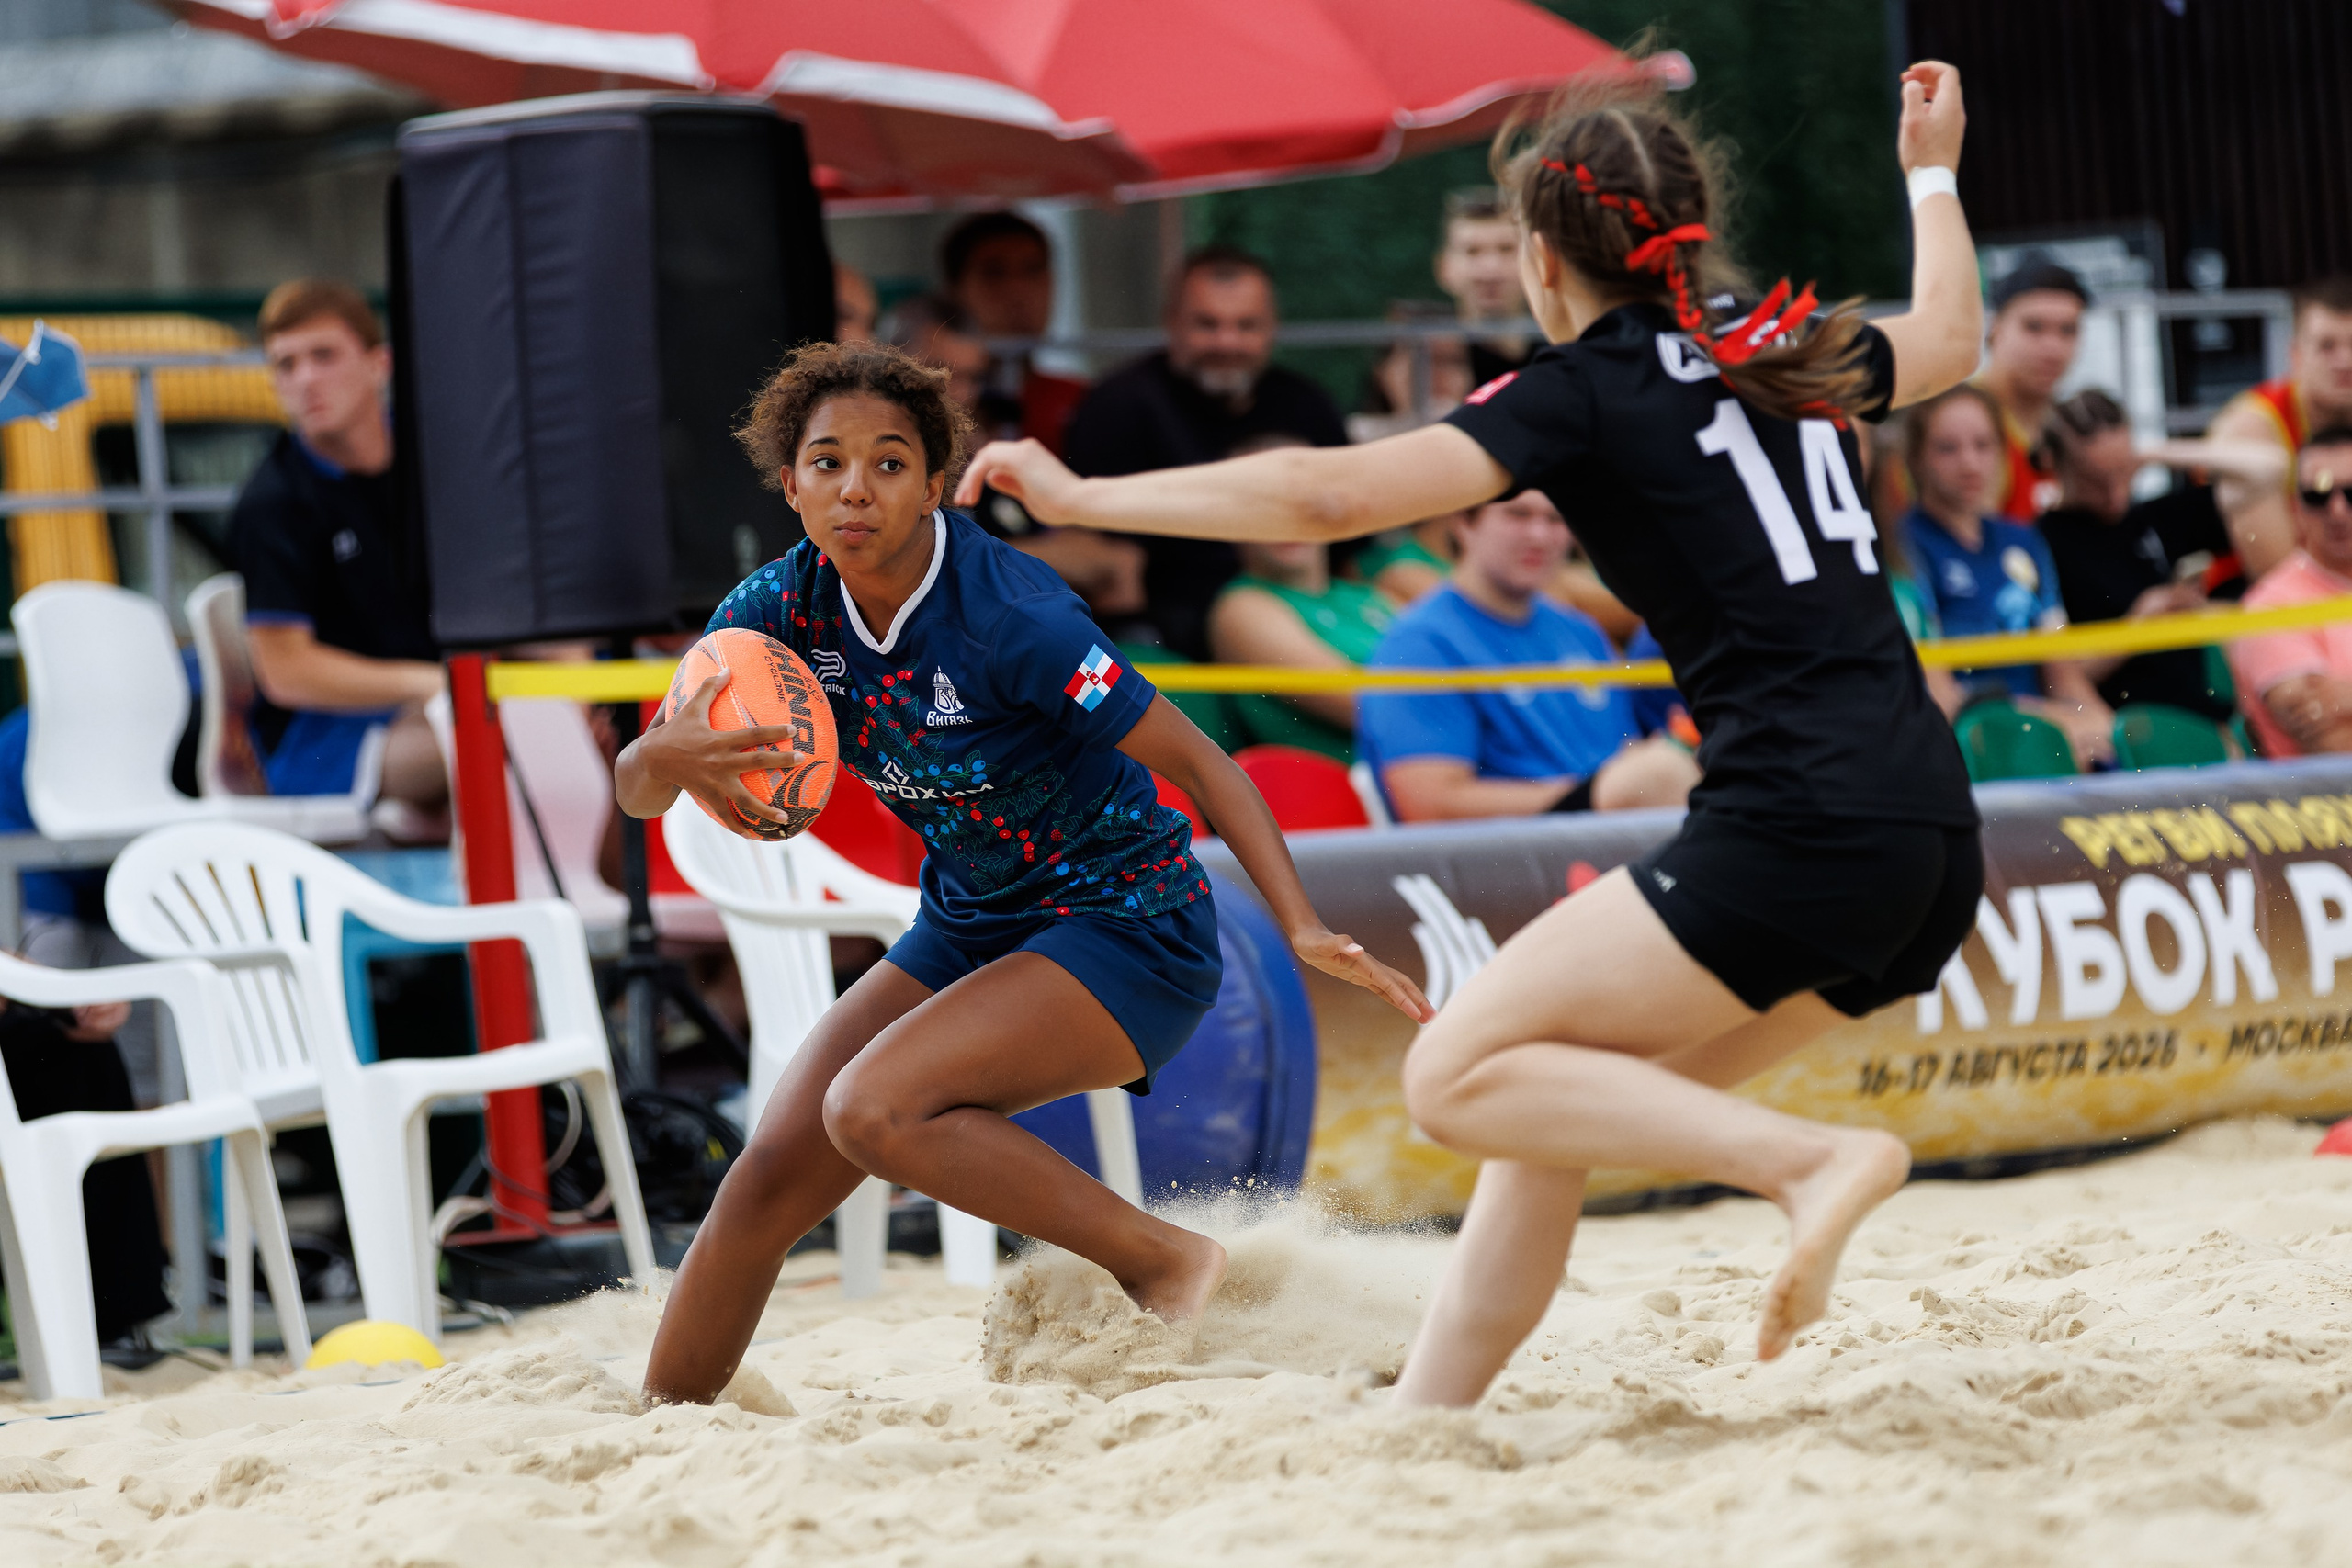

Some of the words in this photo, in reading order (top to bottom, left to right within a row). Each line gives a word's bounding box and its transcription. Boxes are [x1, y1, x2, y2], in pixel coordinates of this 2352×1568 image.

[1694, 397, 1879, 586] 14
[2060, 806, 2248, 869] РЕГБИ
[1945, 1036, 2090, 1088] АВГУСТА
